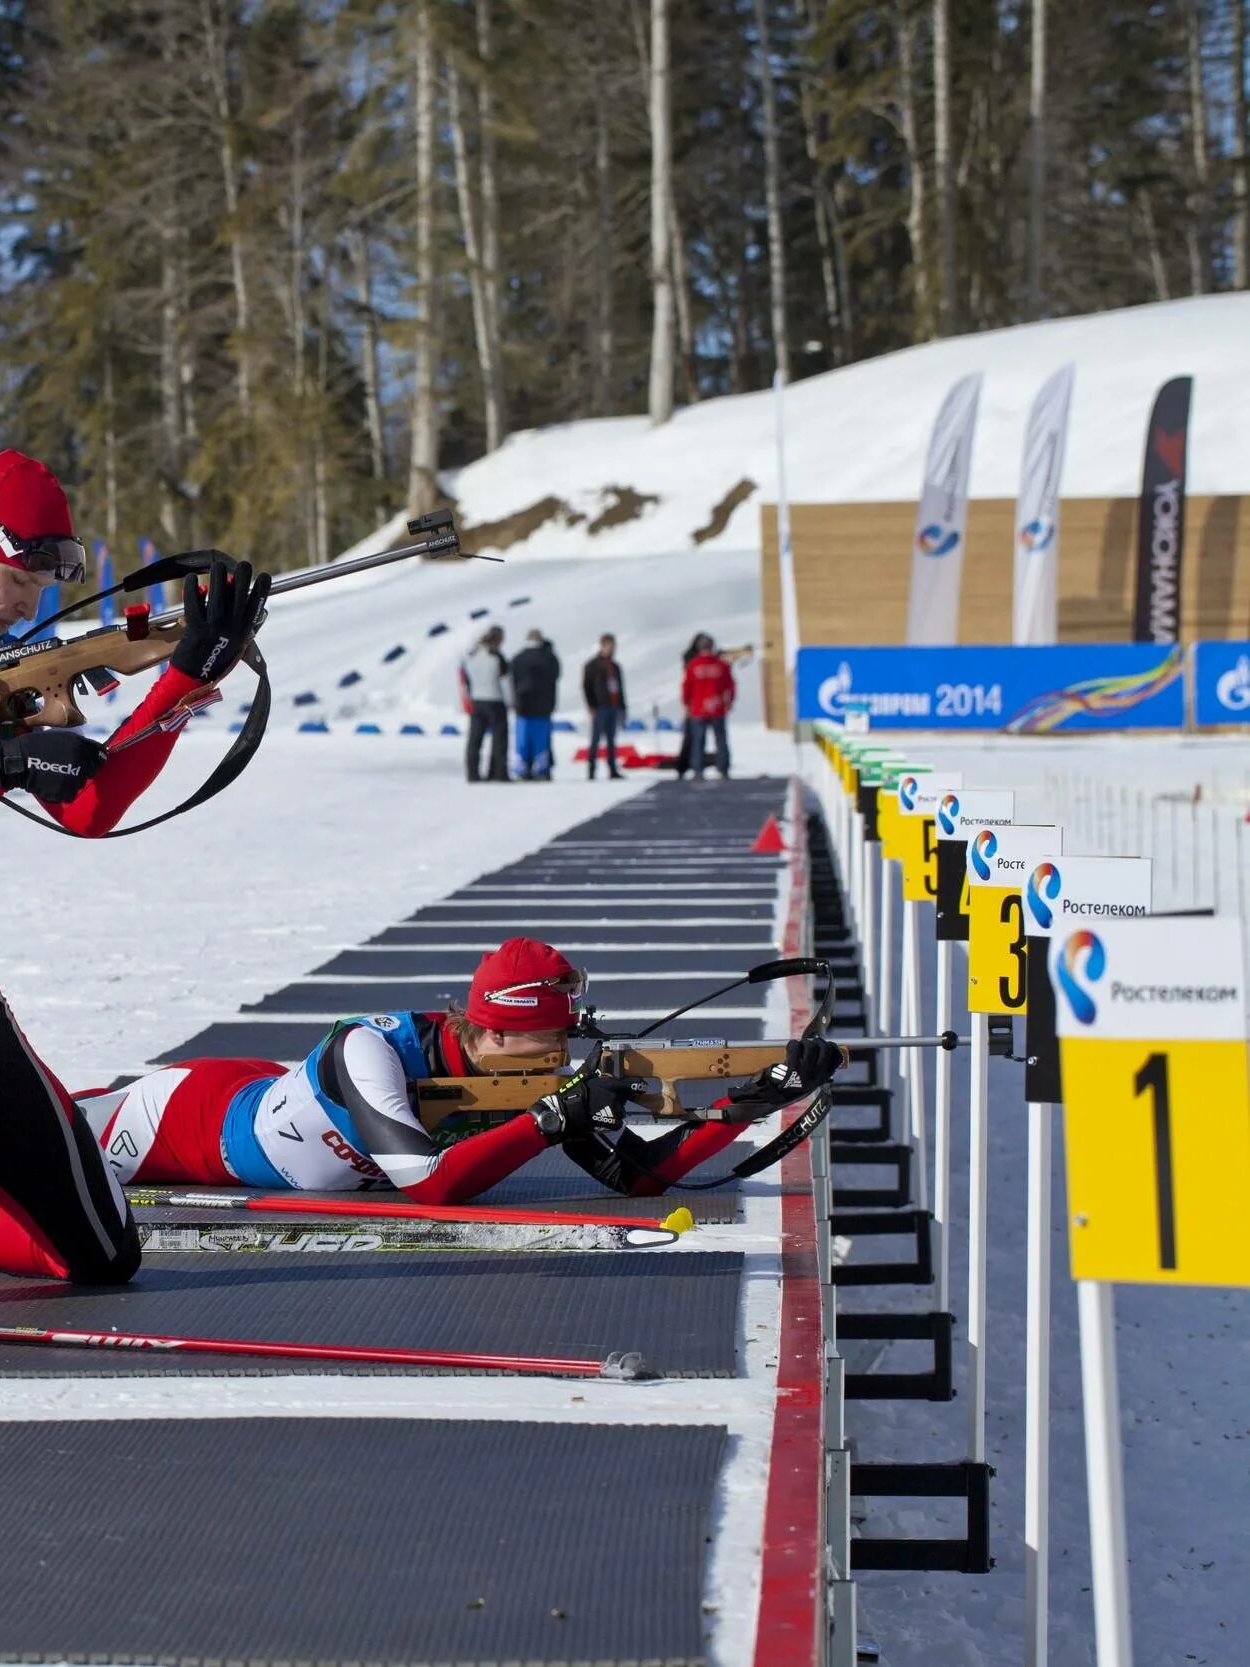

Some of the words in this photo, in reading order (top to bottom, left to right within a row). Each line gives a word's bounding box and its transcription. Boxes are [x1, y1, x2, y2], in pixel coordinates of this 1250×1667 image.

[0, 640, 52, 662] ANSCHUTZ
[935, 683, 1002, 716] 2014
[960, 816, 1012, 827] Ростелеком
[1062, 899, 1146, 917] Ростелеком
[999, 894, 1027, 1008] 3
[1111, 982, 1237, 1003] Ростелеком
[592, 1114, 616, 1125] adidas
[1134, 1052, 1177, 1271] 1
